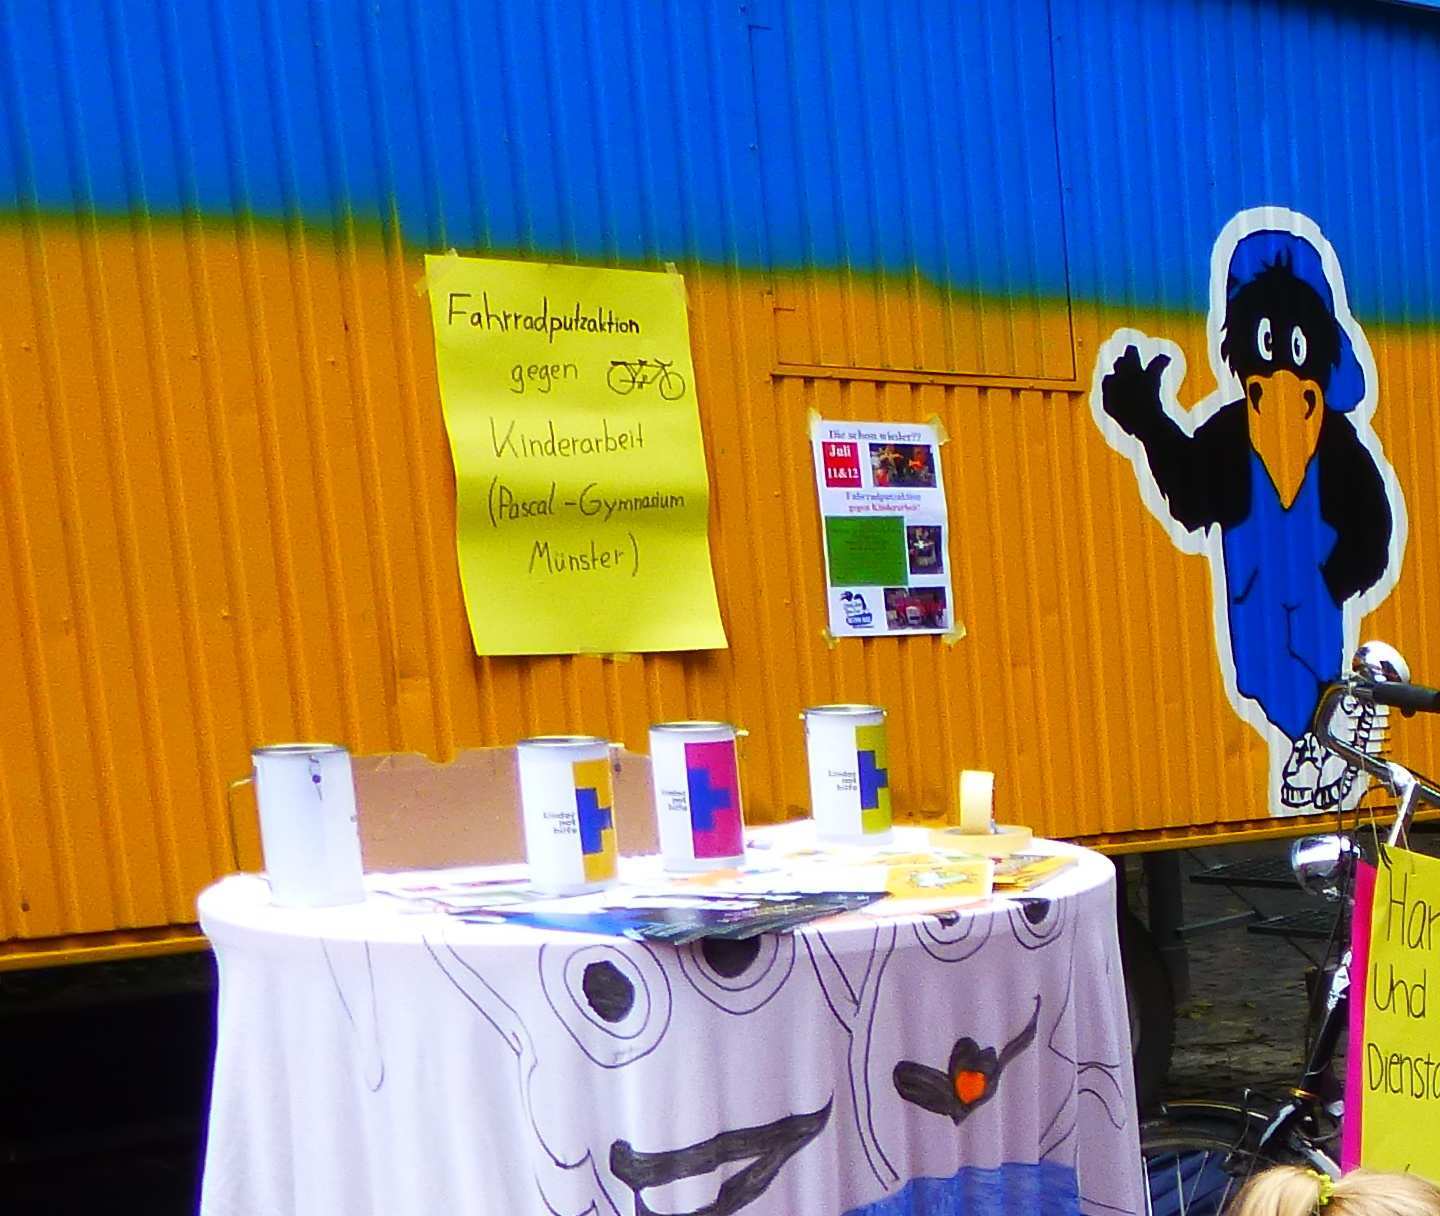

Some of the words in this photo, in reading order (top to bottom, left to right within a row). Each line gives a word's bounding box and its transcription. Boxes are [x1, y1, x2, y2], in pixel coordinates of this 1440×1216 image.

[449, 291, 640, 344] Fahrradputzaktion
[510, 362, 578, 394] gegen
[489, 416, 644, 458] Kinderarbeit
[829, 444, 851, 458] Juli
